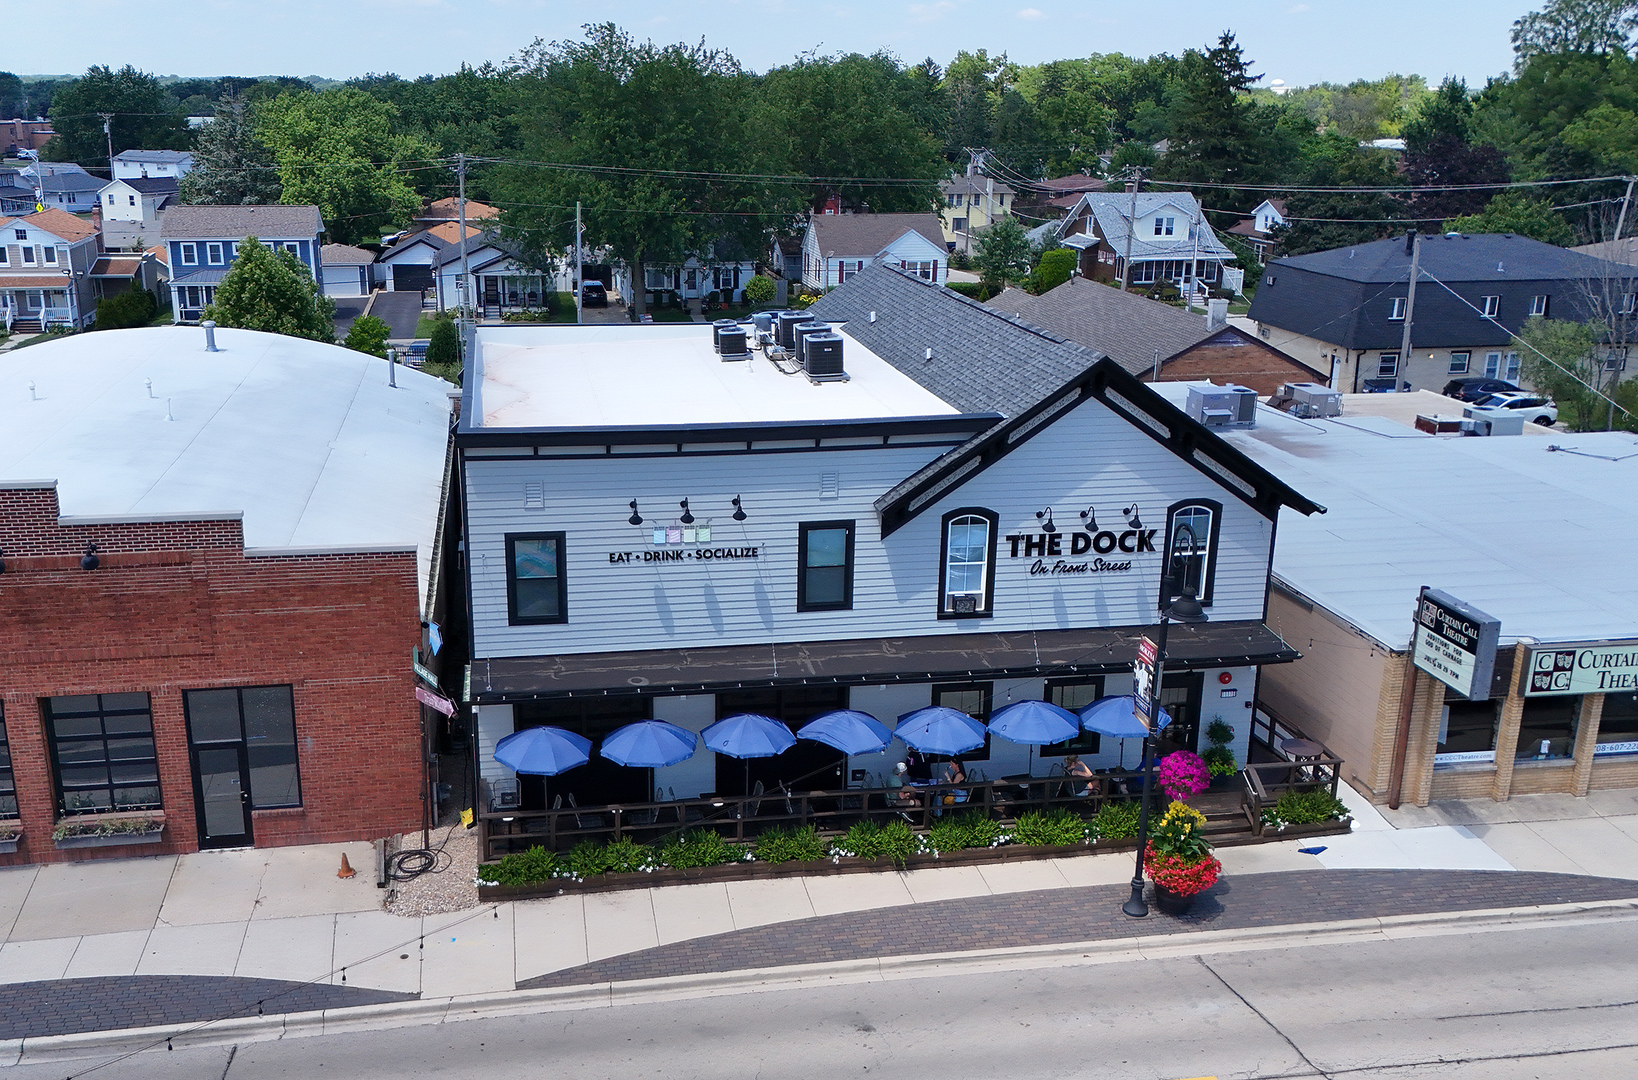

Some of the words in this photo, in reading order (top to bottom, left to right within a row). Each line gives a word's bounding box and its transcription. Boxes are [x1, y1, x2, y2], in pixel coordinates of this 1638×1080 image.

[1006, 533, 1062, 557] THE
[1071, 529, 1158, 555] DOCK
[609, 552, 632, 563] EAT
[644, 550, 684, 561] DRINK
[695, 547, 758, 559] SOCIALIZE
[1030, 559, 1048, 575] On
[1051, 558, 1088, 574] Front
[1090, 557, 1132, 572] Street
[1443, 623, 1469, 646] THEATRE
[1462, 622, 1478, 640] CALL
[1594, 743, 1638, 752] 08-607-22
